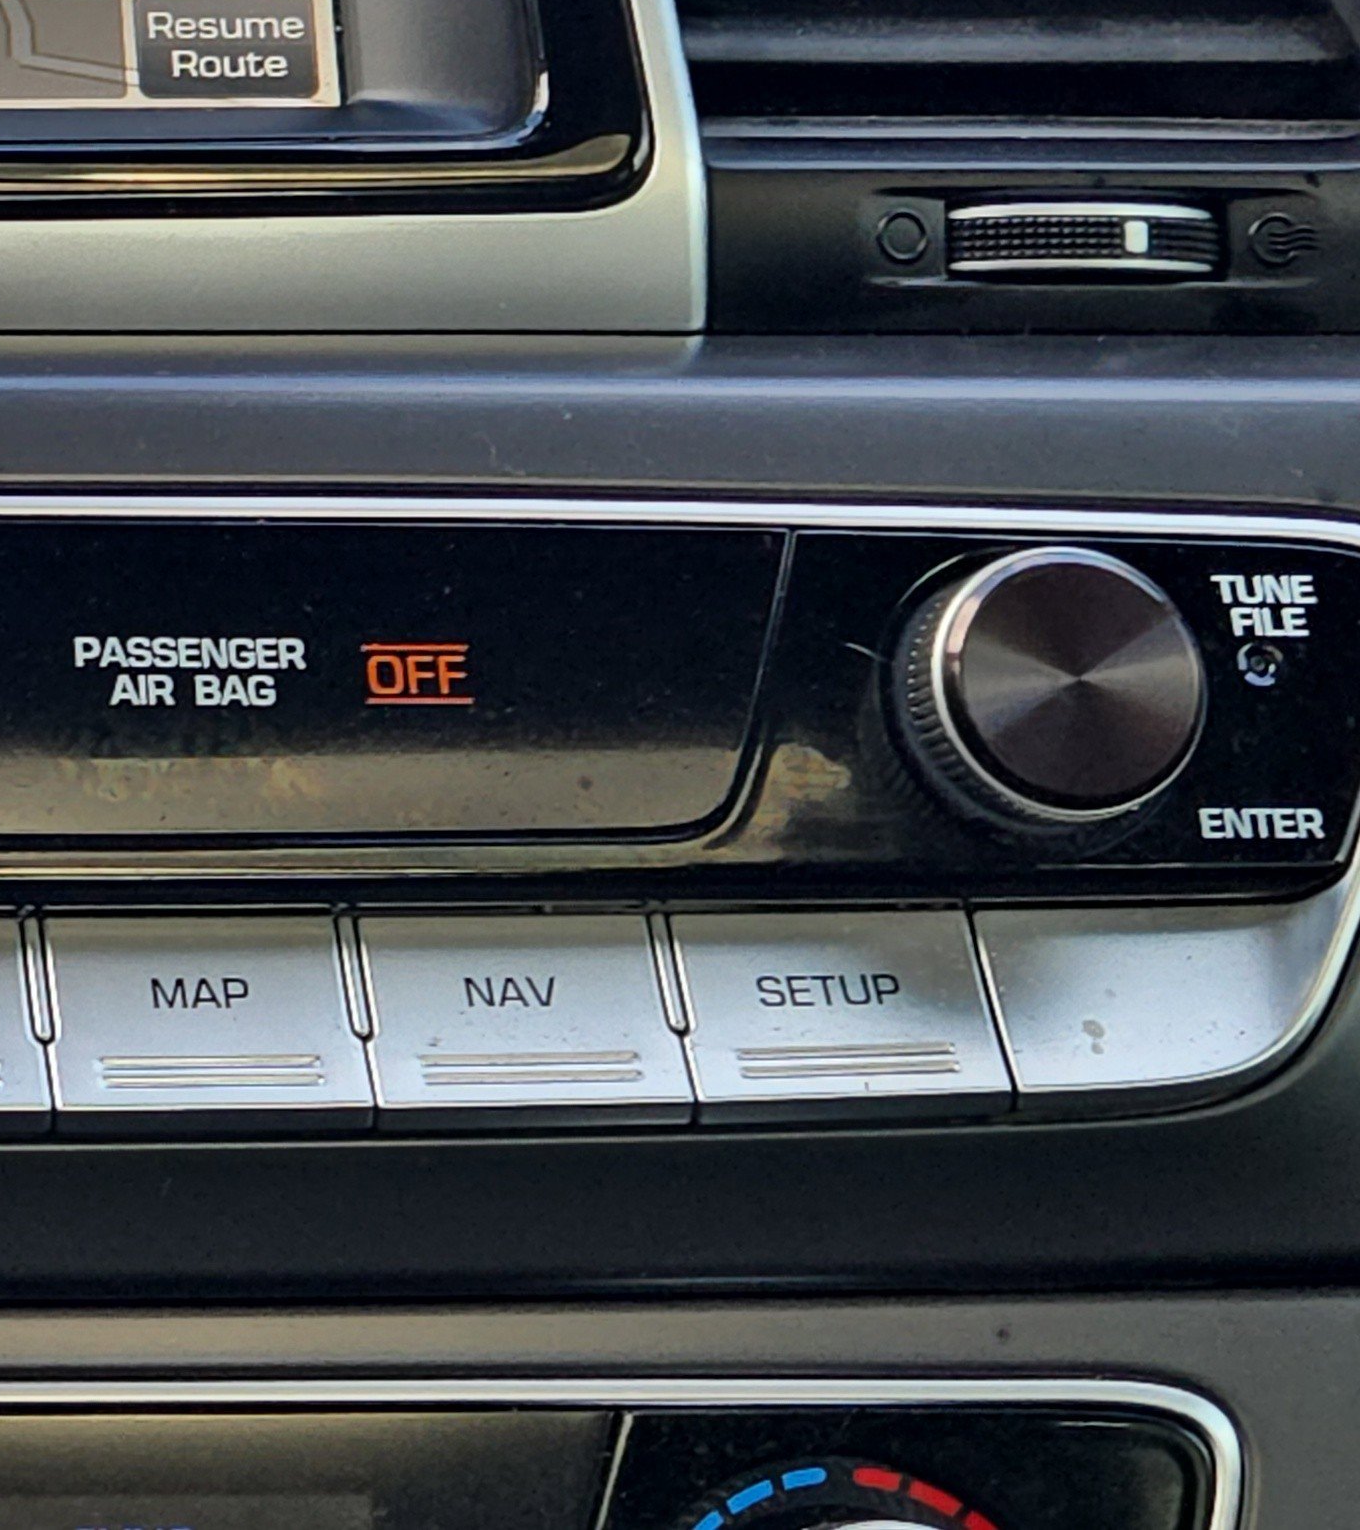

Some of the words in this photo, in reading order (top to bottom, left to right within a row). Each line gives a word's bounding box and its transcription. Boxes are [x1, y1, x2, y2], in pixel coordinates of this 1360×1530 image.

[146, 11, 306, 40] Resume
[170, 49, 289, 79] Route
[1209, 573, 1319, 605] TUNE
[1229, 606, 1311, 638] FILE
[72, 636, 307, 670] PASSENGER
[108, 674, 176, 707] AIR
[193, 674, 278, 708] BAG
[365, 653, 468, 696] OFF
[1197, 807, 1326, 840] ENTER
[149, 977, 250, 1011] MAP
[463, 975, 558, 1010] NAV
[757, 972, 902, 1009] SETUP
